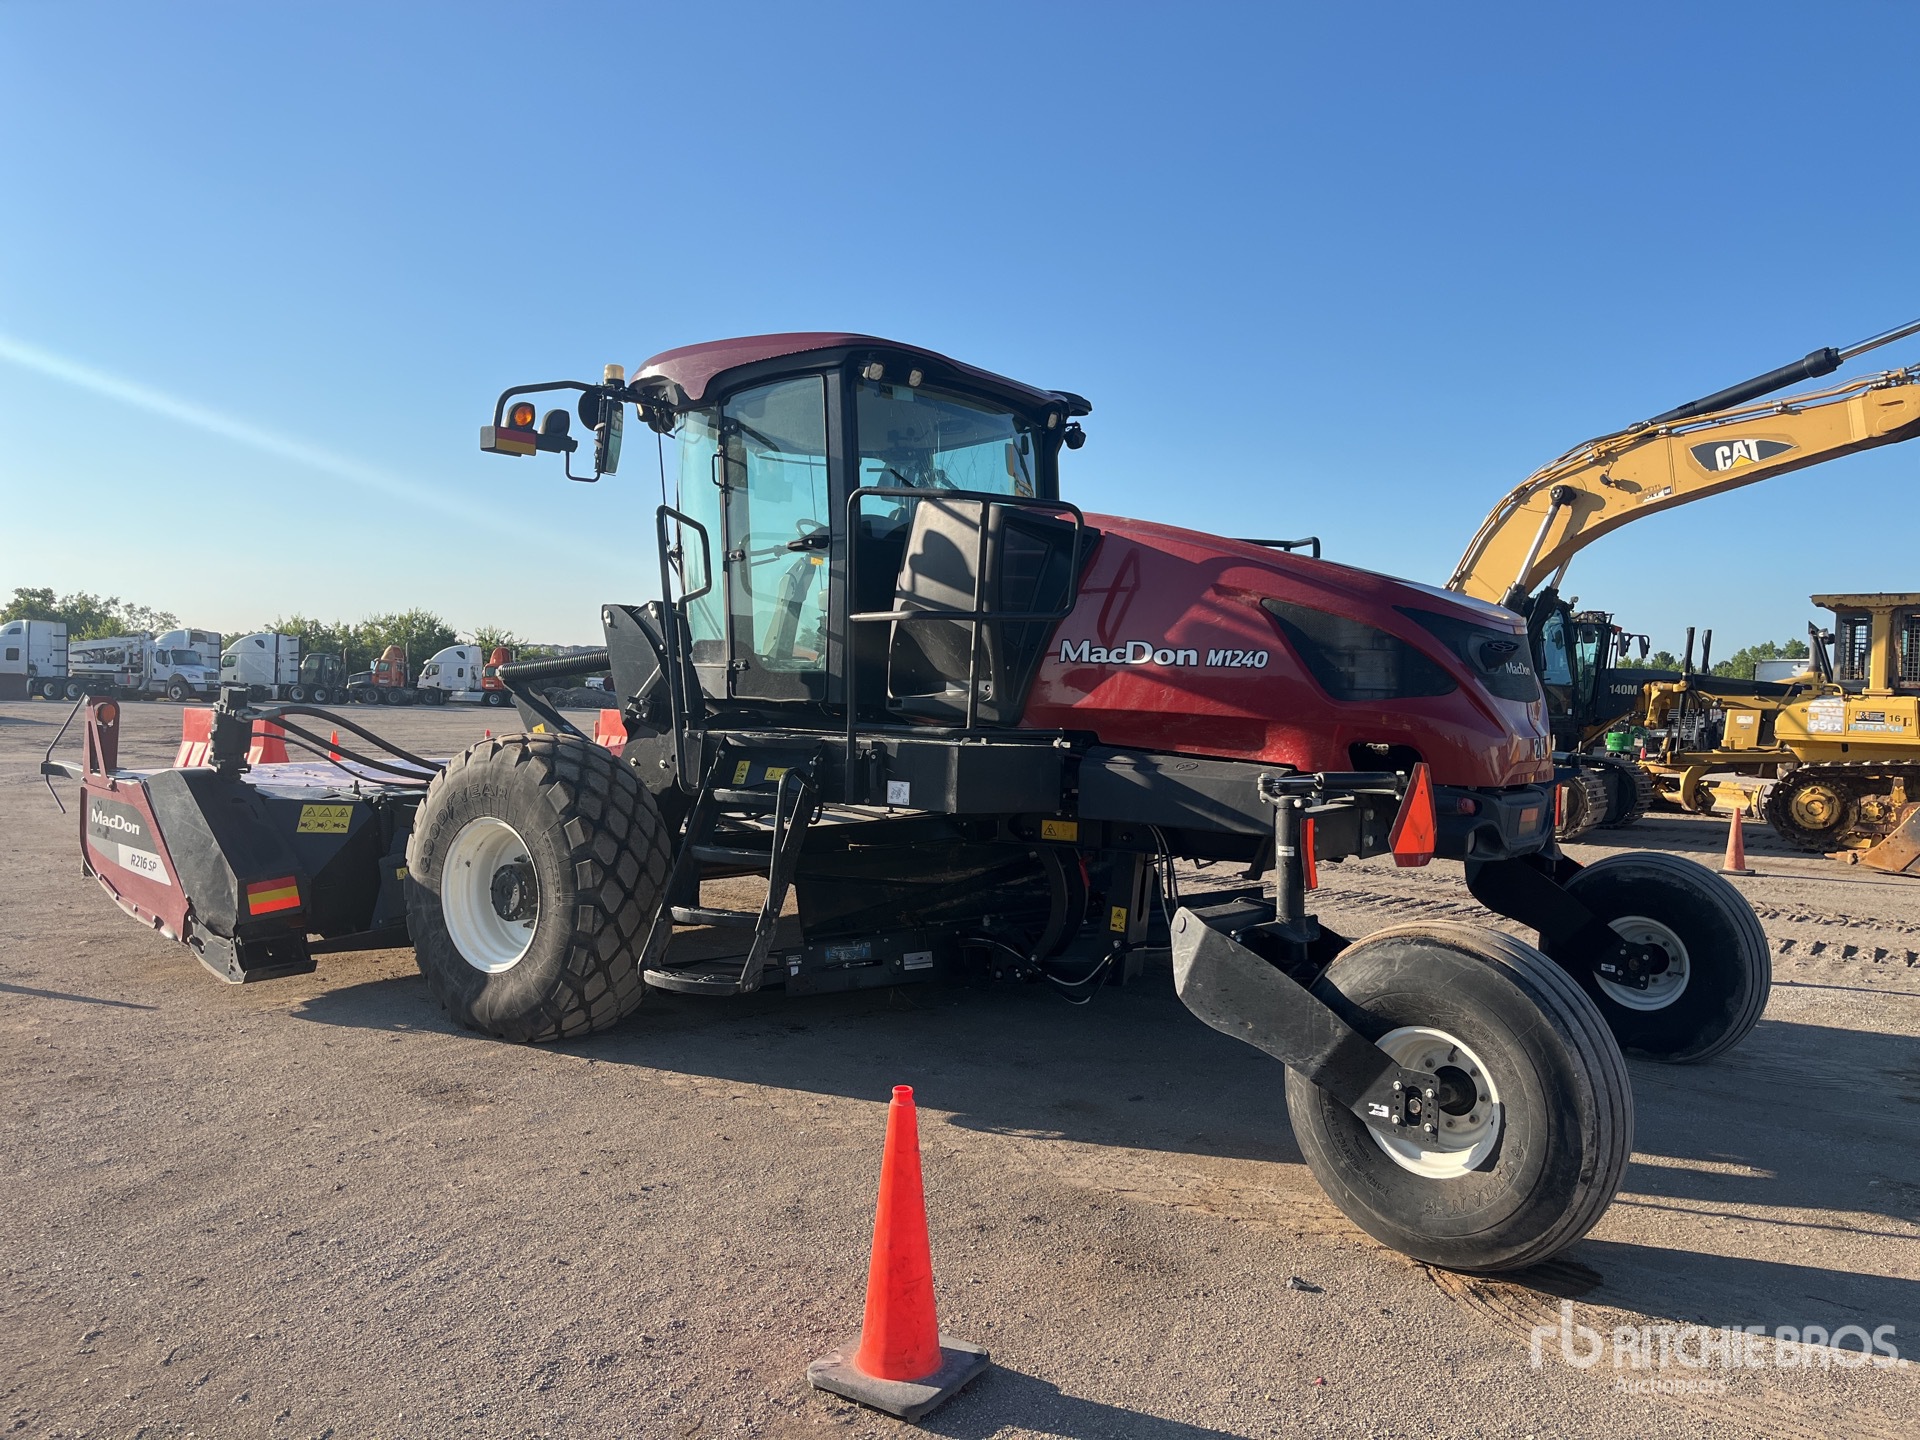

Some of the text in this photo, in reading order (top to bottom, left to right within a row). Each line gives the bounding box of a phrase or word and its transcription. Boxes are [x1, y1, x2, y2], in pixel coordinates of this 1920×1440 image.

[1715, 438, 1760, 472] CAT
[1059, 639, 1269, 669] MacDon M1240
[1505, 661, 1531, 676] MacDon
[1609, 684, 1638, 695] 140M
[1889, 714, 1901, 723] 16
[91, 808, 141, 836] MacDon
[130, 853, 157, 872] R216 SP
